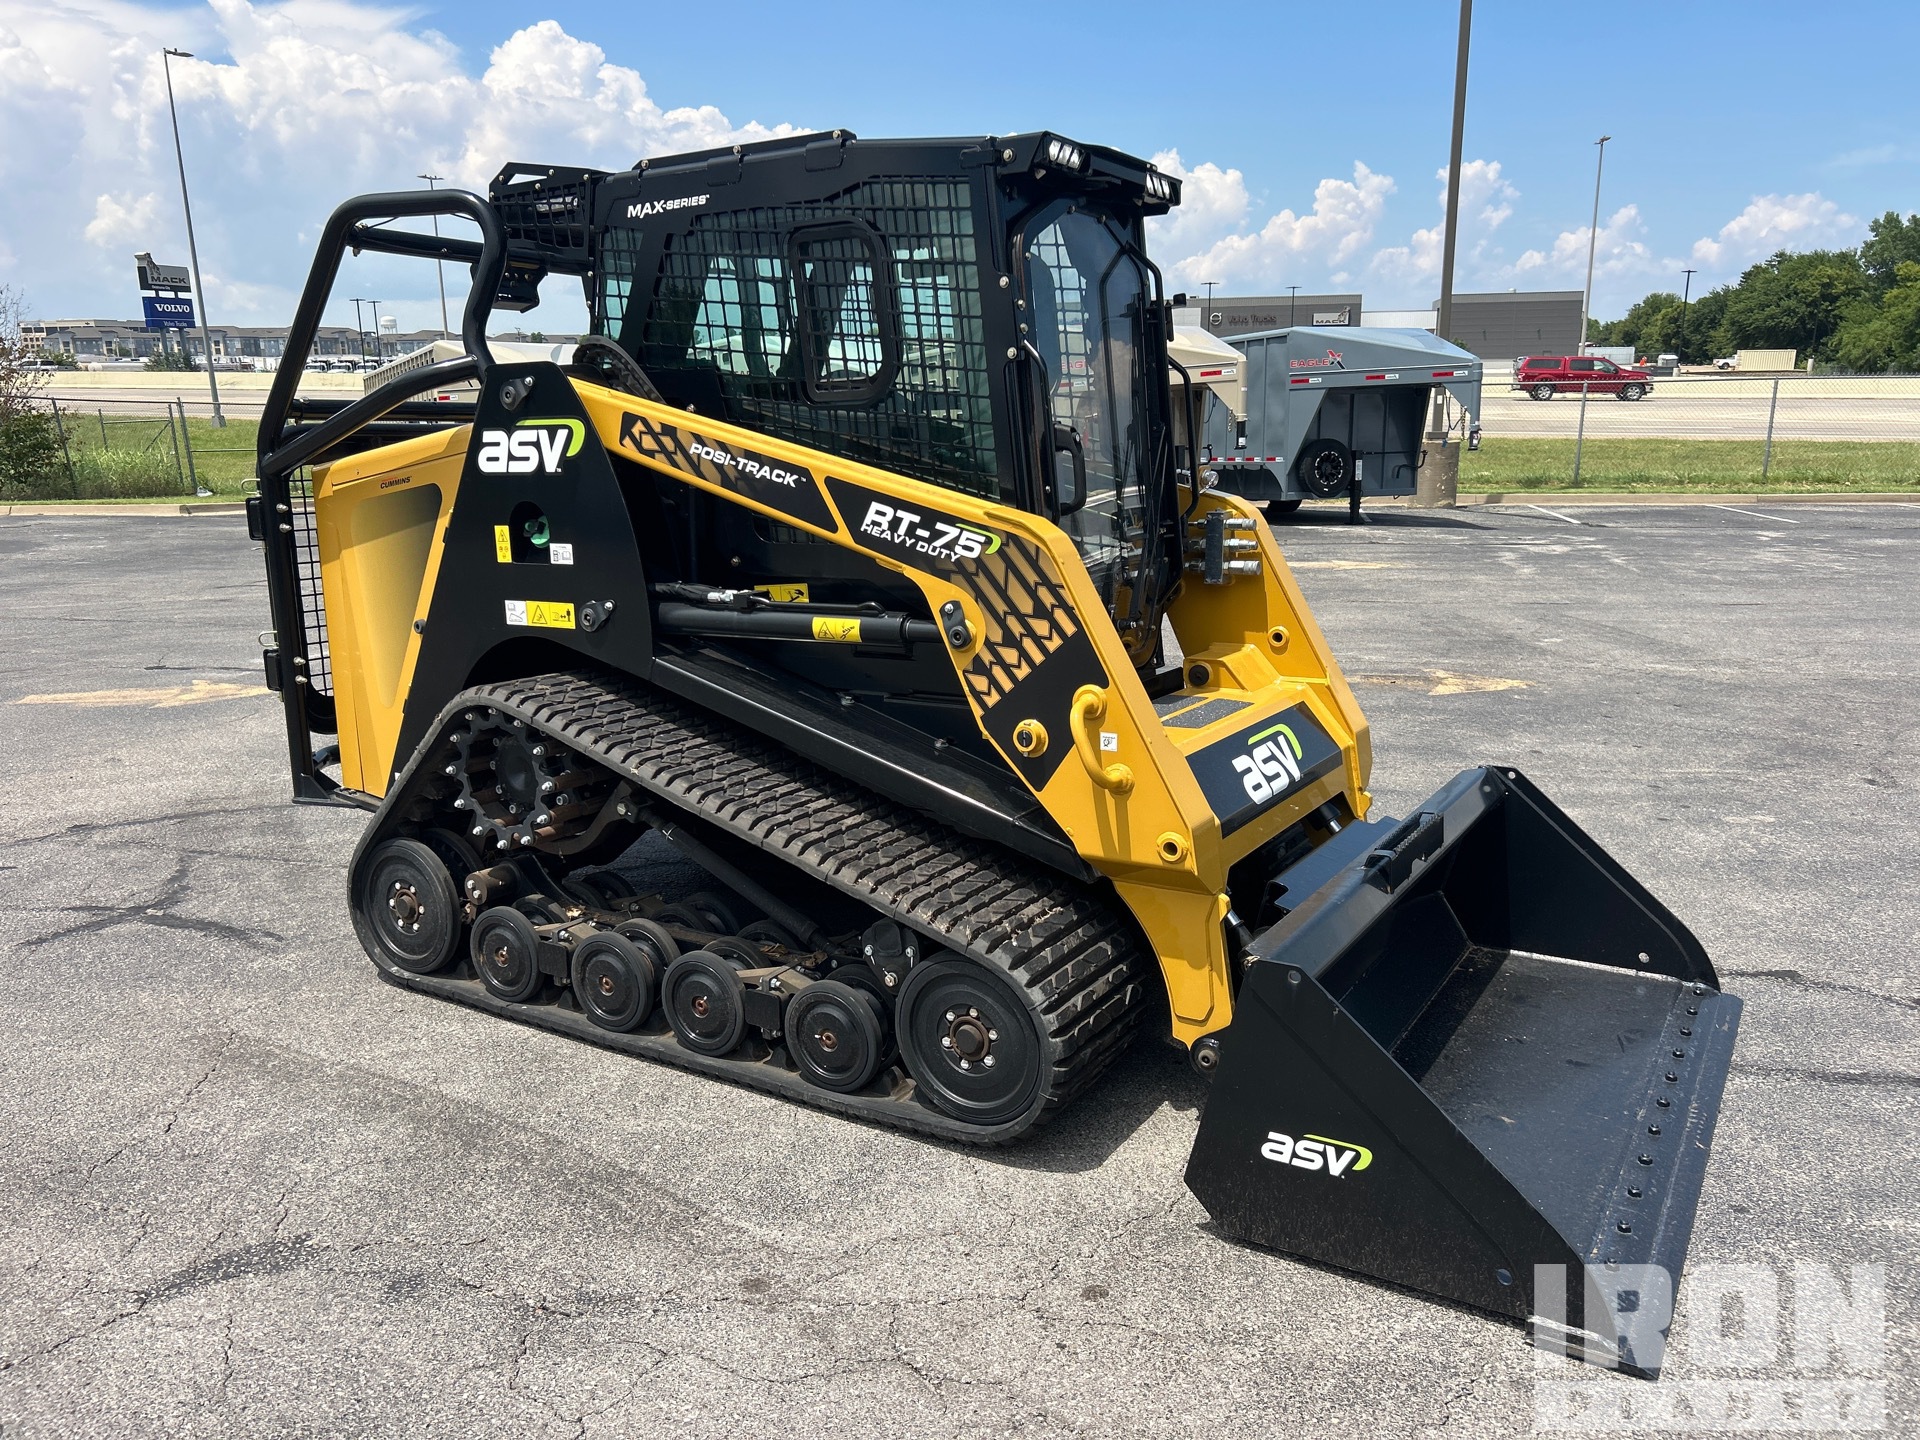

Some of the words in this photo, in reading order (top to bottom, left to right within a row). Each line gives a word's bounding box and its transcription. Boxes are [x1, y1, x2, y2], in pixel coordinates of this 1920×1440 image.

[151, 275, 187, 284] MACK
[154, 303, 190, 313] VOLVO
[689, 442, 799, 488] POSI-TRACK
[380, 476, 411, 489] CUMMINS
[860, 523, 916, 547] HEAVY
[915, 541, 961, 562] DUTY
[863, 501, 986, 558] RT-75
